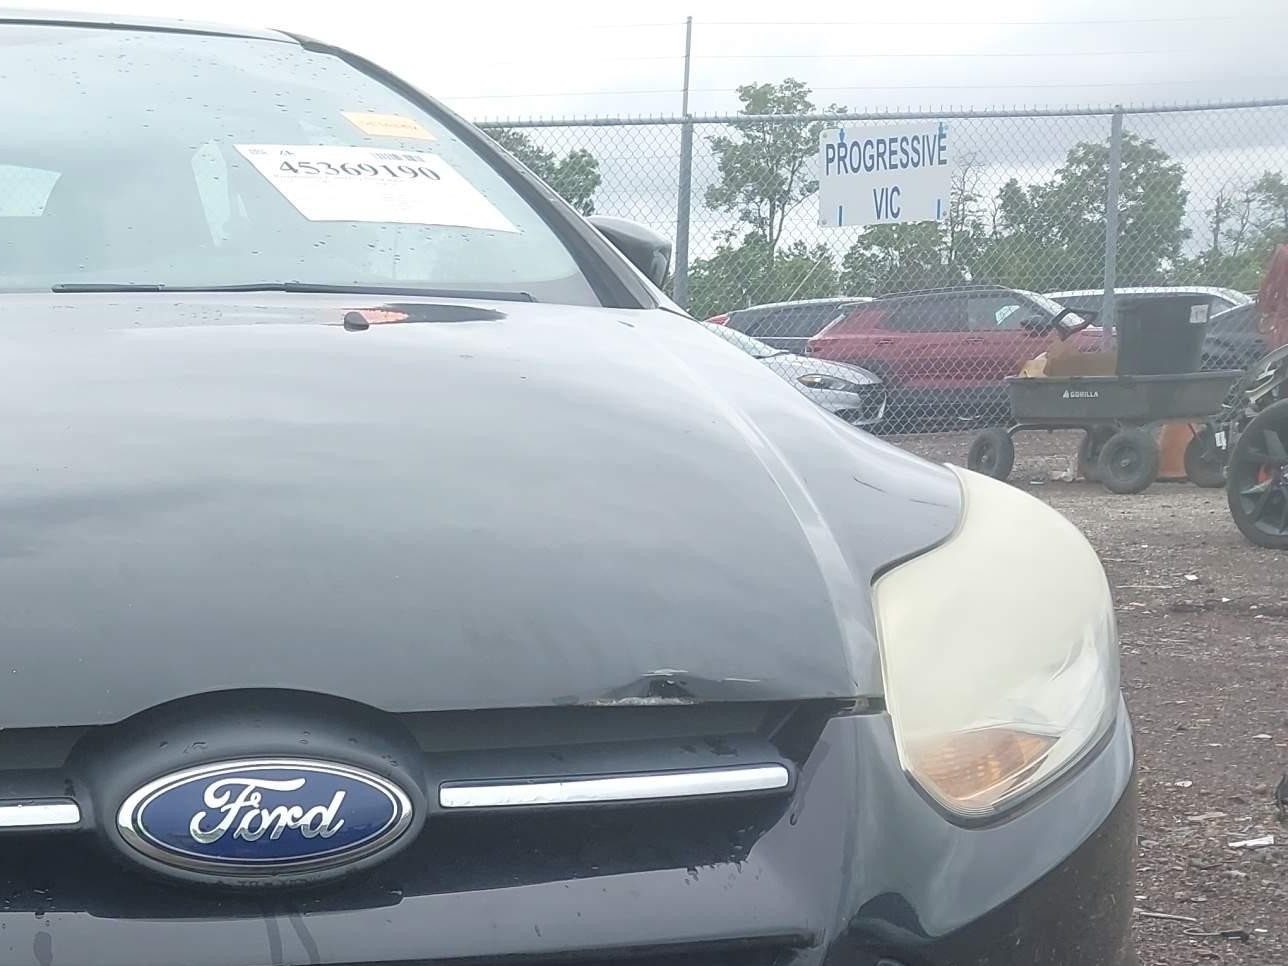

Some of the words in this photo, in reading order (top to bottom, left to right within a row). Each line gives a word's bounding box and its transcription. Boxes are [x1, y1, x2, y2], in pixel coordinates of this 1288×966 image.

[278, 160, 441, 181] 45369190
[825, 133, 948, 176] PROGRESSIVE
[872, 186, 902, 220] VIC
[189, 777, 346, 844] Ford
